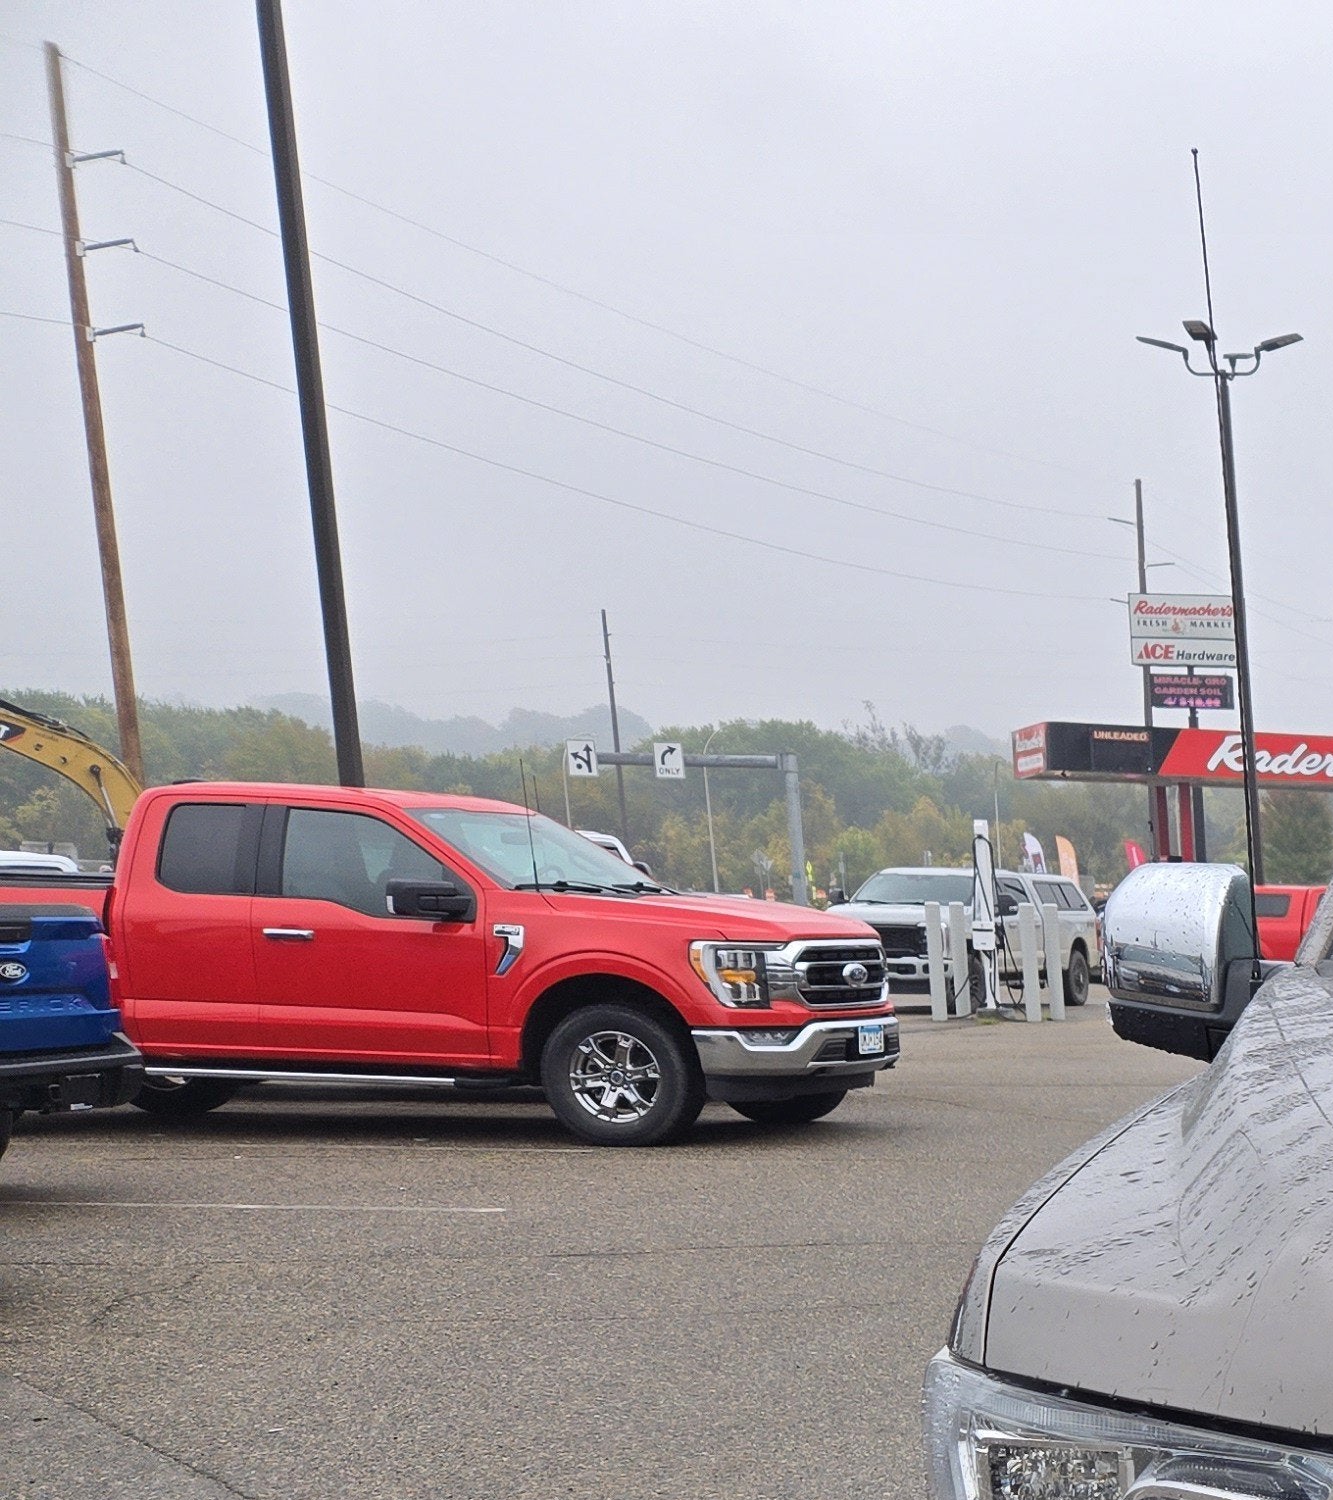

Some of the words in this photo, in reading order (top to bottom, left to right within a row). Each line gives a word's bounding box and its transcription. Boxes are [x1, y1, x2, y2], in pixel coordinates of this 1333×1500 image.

[1133, 600, 1233, 617] Radermacher's
[1137, 619, 1168, 627] FRESH
[1137, 642, 1175, 660] ACE
[1176, 650, 1235, 662] Hardware
[1154, 686, 1198, 695] GARDEN
[1199, 687, 1223, 696] SOIL
[1093, 730, 1148, 741] UNLEADED
[658, 767, 680, 775] ONLY
